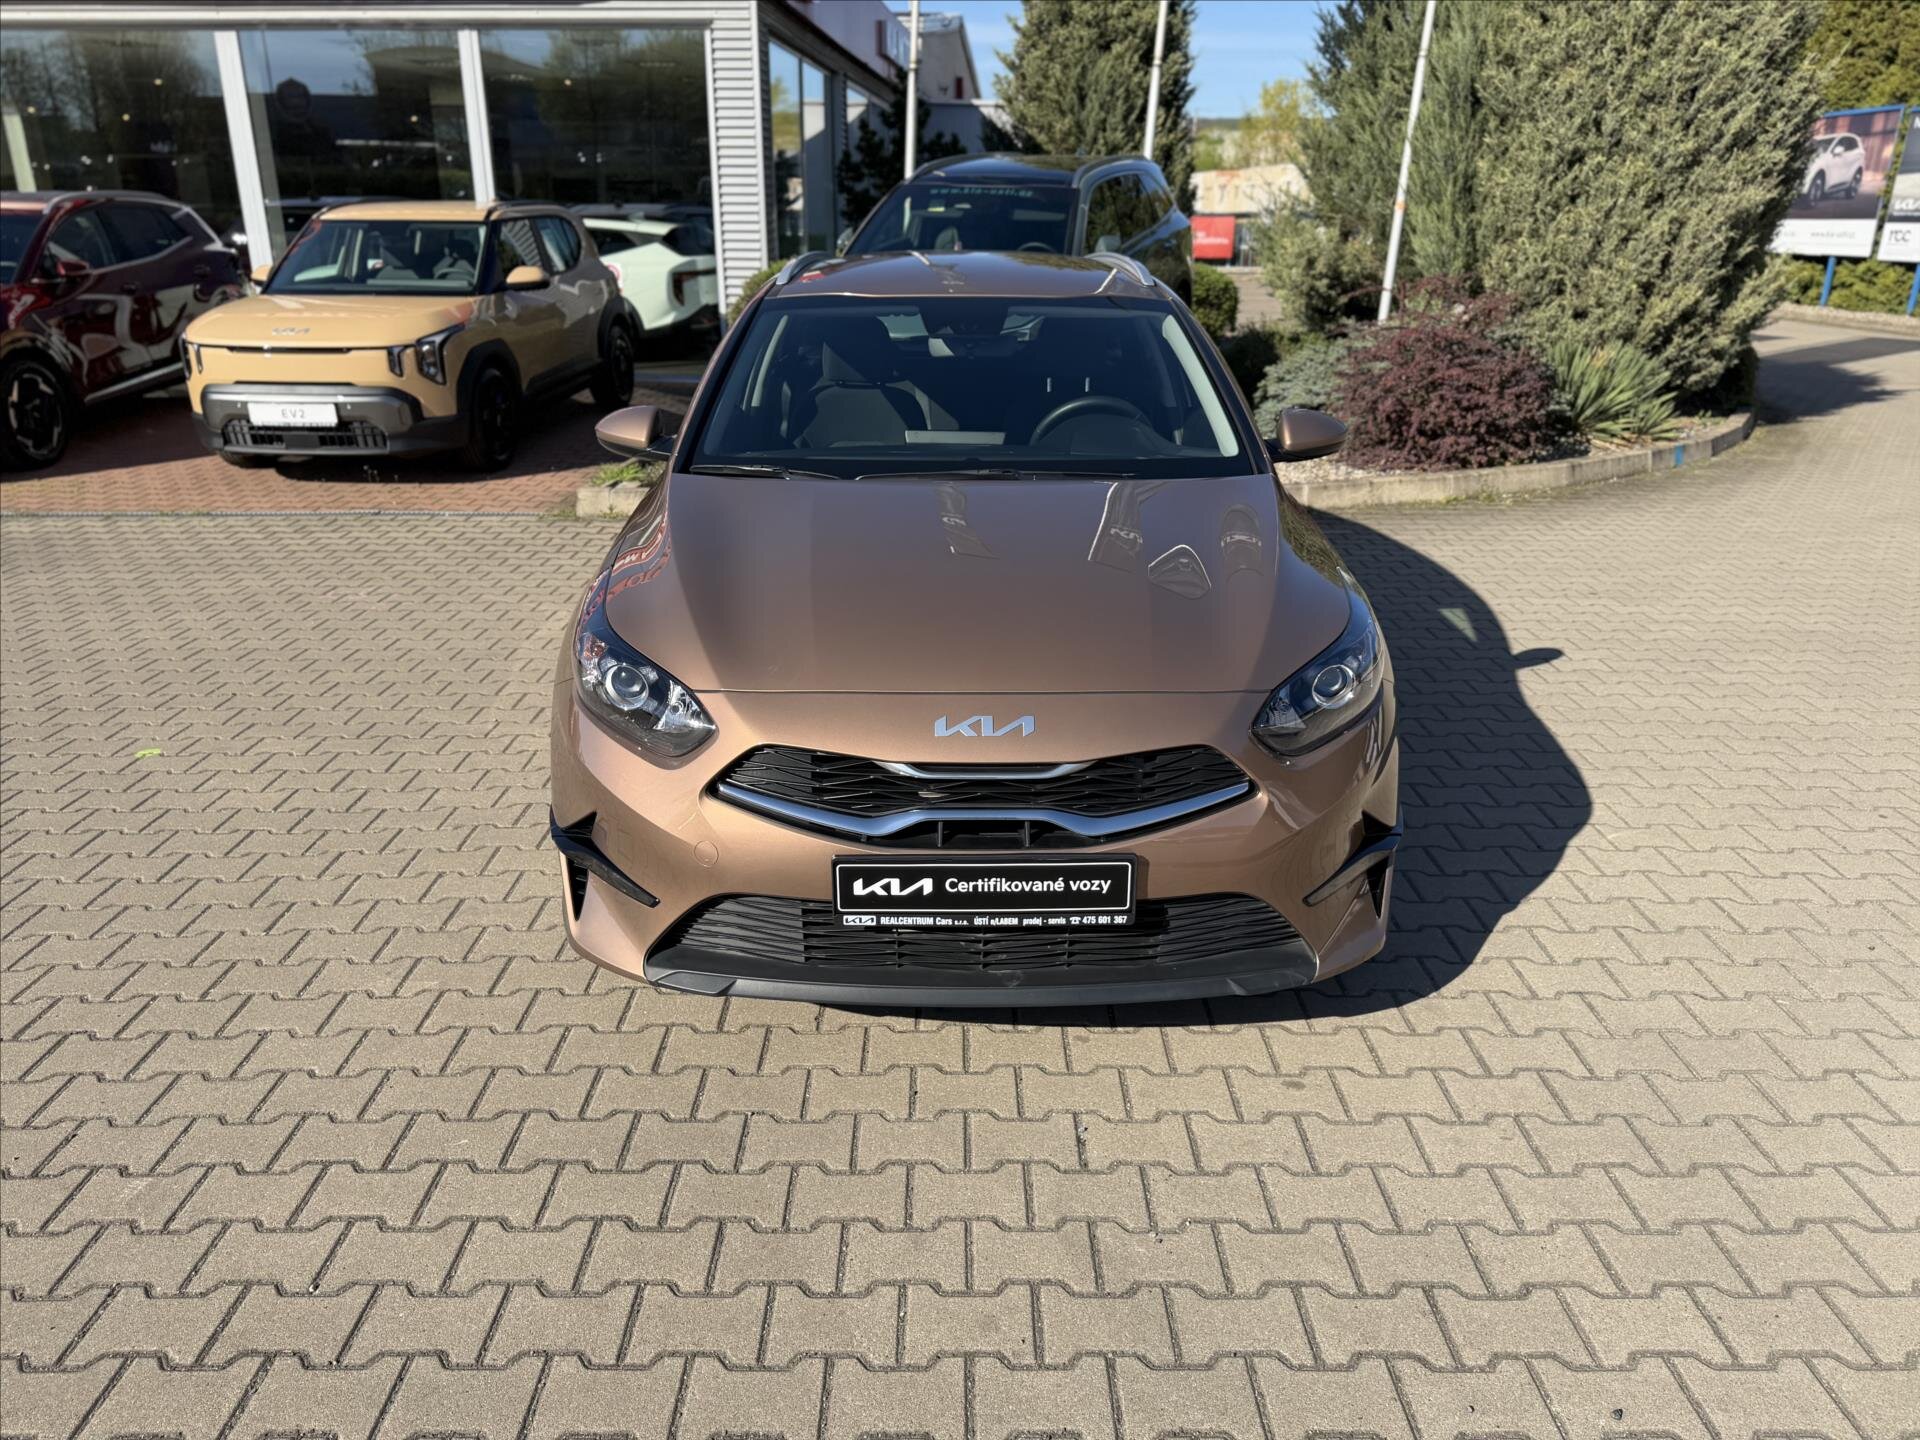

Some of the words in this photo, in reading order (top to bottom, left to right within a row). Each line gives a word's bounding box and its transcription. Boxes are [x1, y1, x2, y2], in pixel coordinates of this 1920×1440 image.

[935, 715, 1035, 737] KIA
[853, 877, 933, 896] KIA
[945, 877, 1064, 893] Certifikované
[1070, 879, 1111, 894] vozy
[844, 916, 876, 925] KIA
[880, 917, 933, 925] REALCENTRUM
[935, 917, 952, 925] Cars
[1023, 918, 1042, 926] prodej
[1048, 917, 1066, 925] servis
[1082, 916, 1096, 924] 475
[1098, 916, 1111, 924] 601
[1114, 916, 1127, 924] 367
